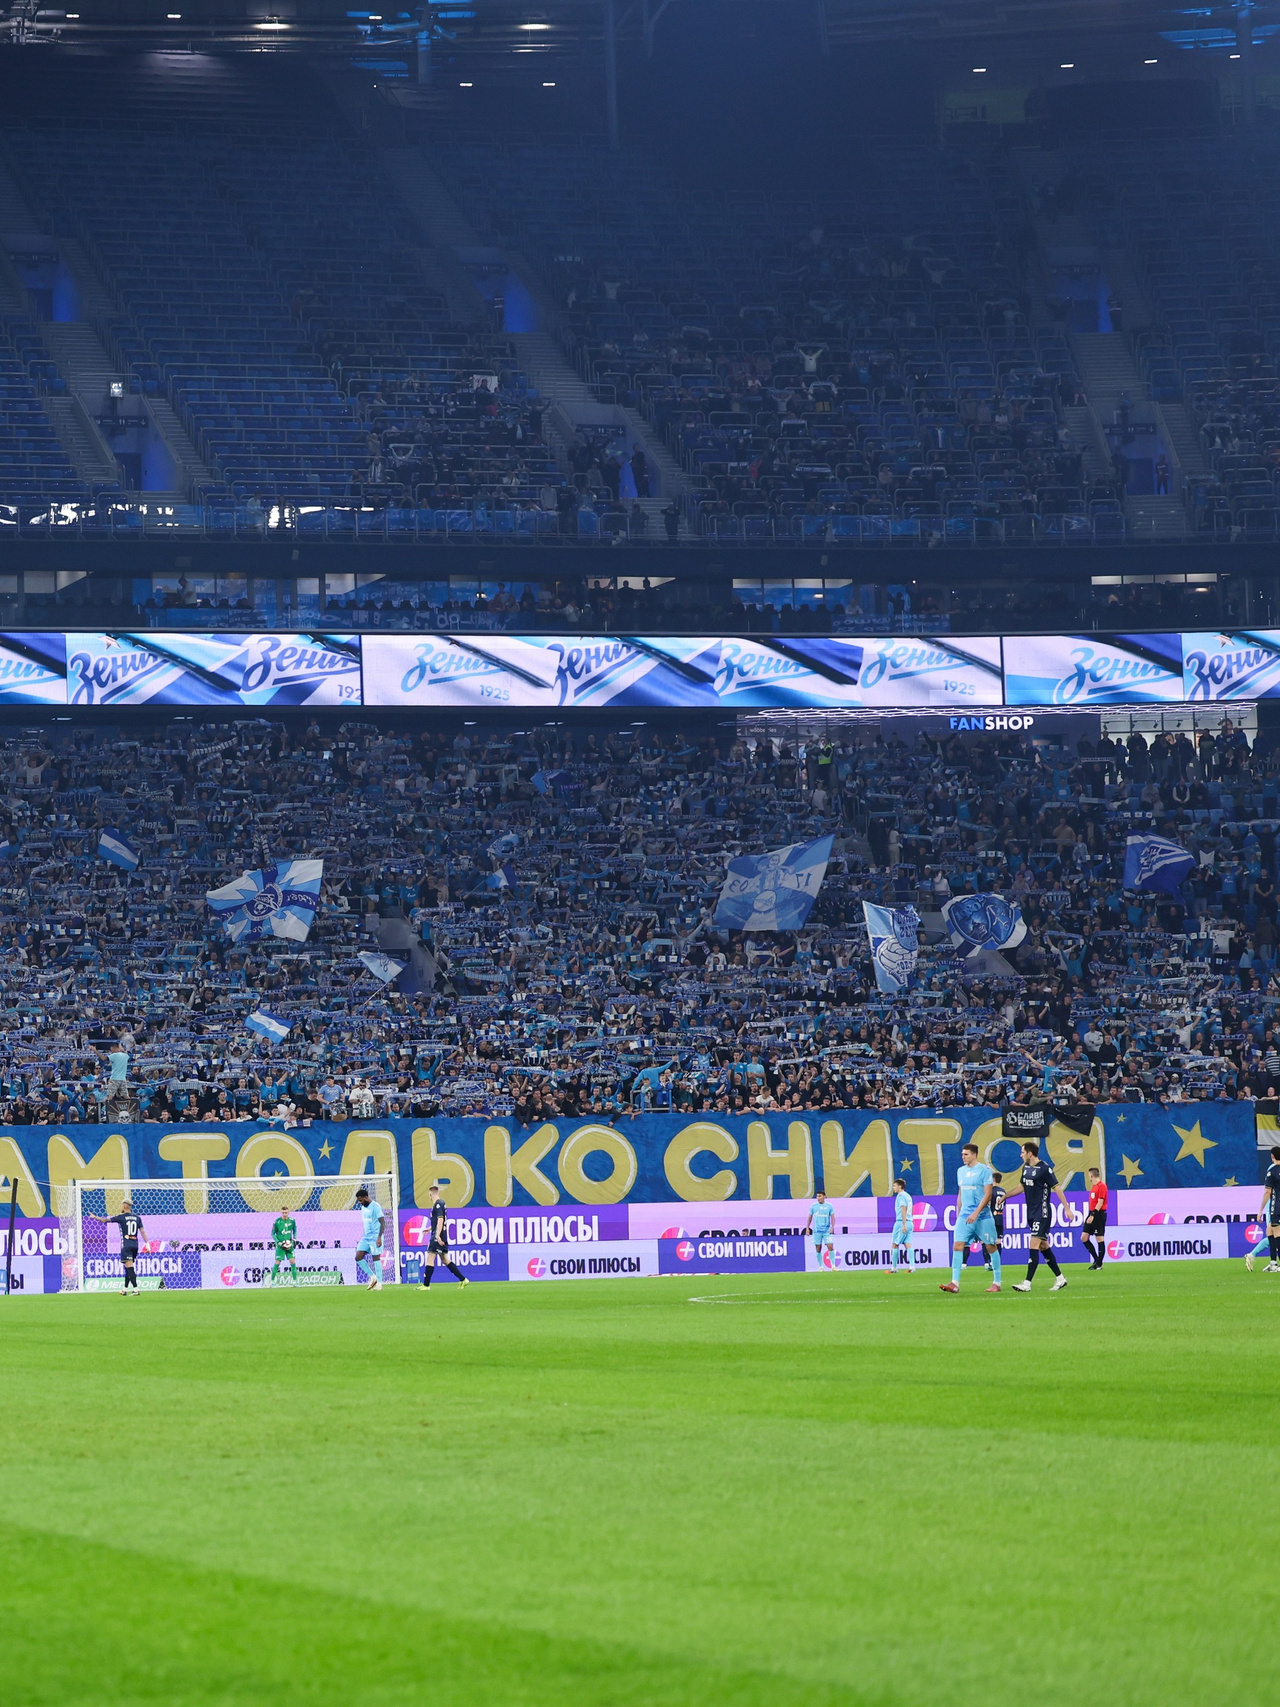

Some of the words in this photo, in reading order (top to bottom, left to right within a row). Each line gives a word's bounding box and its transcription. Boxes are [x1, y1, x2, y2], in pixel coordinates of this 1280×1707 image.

[479, 684, 511, 701] 1925
[943, 679, 976, 696] 1925
[949, 715, 1034, 731] FANSHOP
[1017, 1111, 1044, 1120] СЛАВА
[158, 1122, 638, 1216] ТОЛЬКО
[664, 1116, 1106, 1202] СНИТСЯ
[126, 1221, 137, 1235] 10
[446, 1217, 504, 1245] СВОИ
[509, 1215, 599, 1244] ПЛЮСЫ
[698, 1241, 734, 1258] СВОИ
[737, 1240, 787, 1257] ПЛЮСЫ
[1128, 1241, 1161, 1257] СВОИ
[1163, 1239, 1212, 1256] ПЛЮСЫ
[550, 1258, 585, 1275] СВОИ
[588, 1257, 641, 1274] ПЛЮСЫ
[844, 1250, 879, 1266] СВОИ
